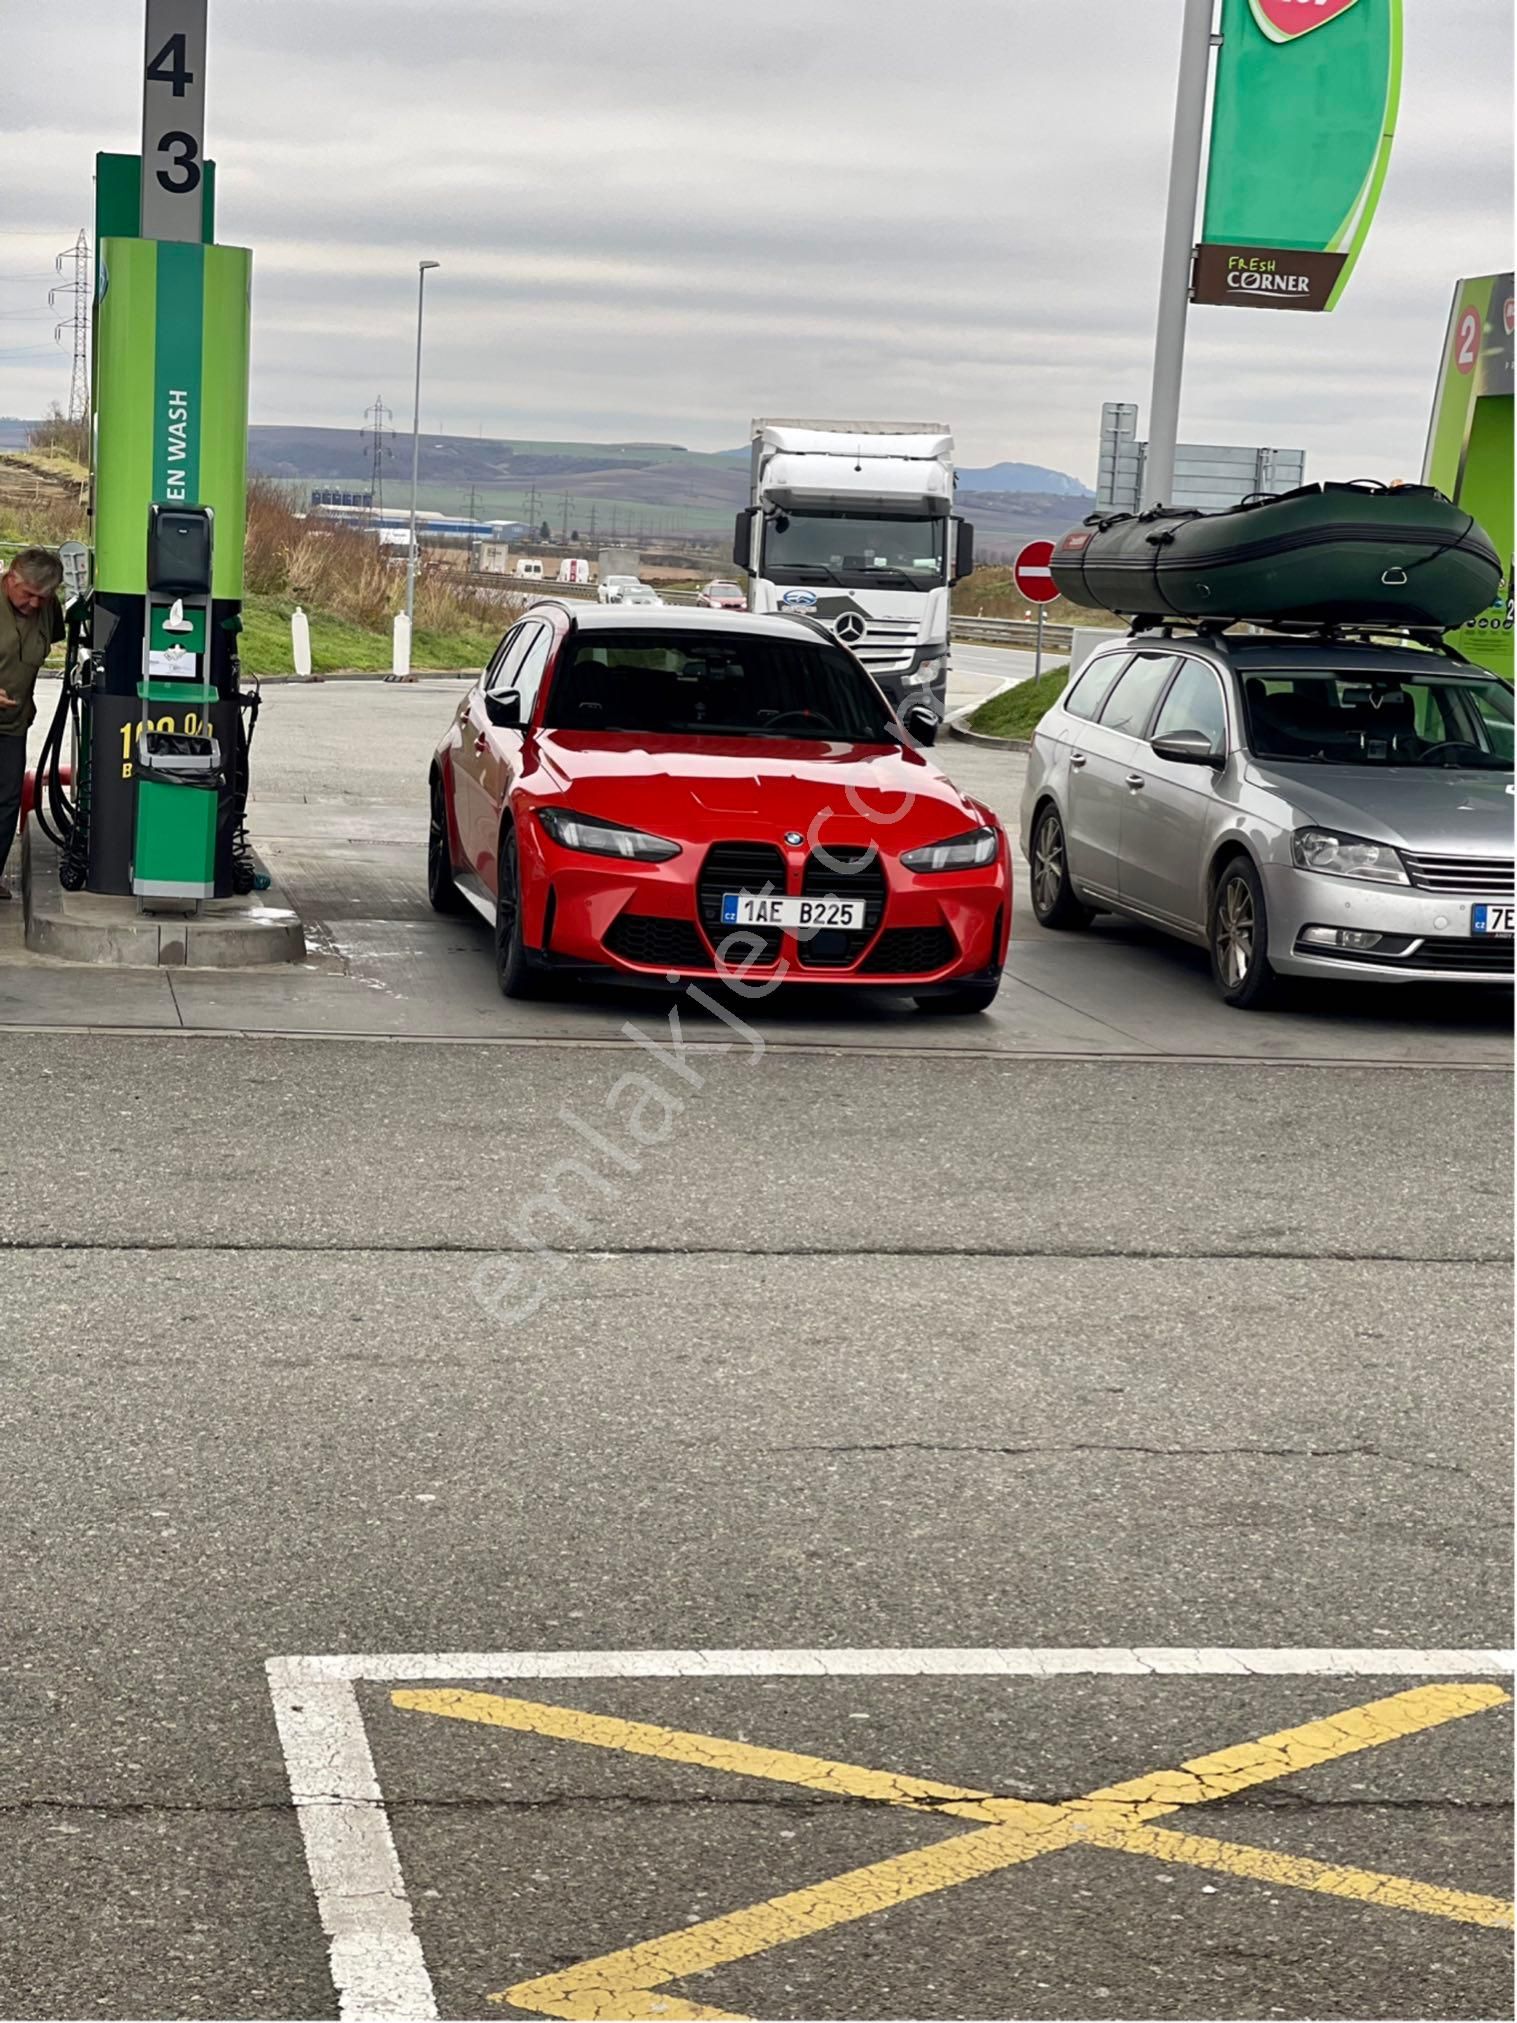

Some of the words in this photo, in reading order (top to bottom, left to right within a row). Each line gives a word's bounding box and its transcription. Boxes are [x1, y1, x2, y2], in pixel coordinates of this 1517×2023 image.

[146, 33, 194, 98] 4
[156, 131, 201, 194] 3
[1227, 271, 1310, 292] CORNER
[1228, 255, 1276, 272] FRESH
[1458, 314, 1476, 364] 2
[168, 390, 188, 461] WASH
[744, 900, 784, 923] 1AE
[799, 902, 854, 926] B225
[1491, 908, 1514, 930] 7E
